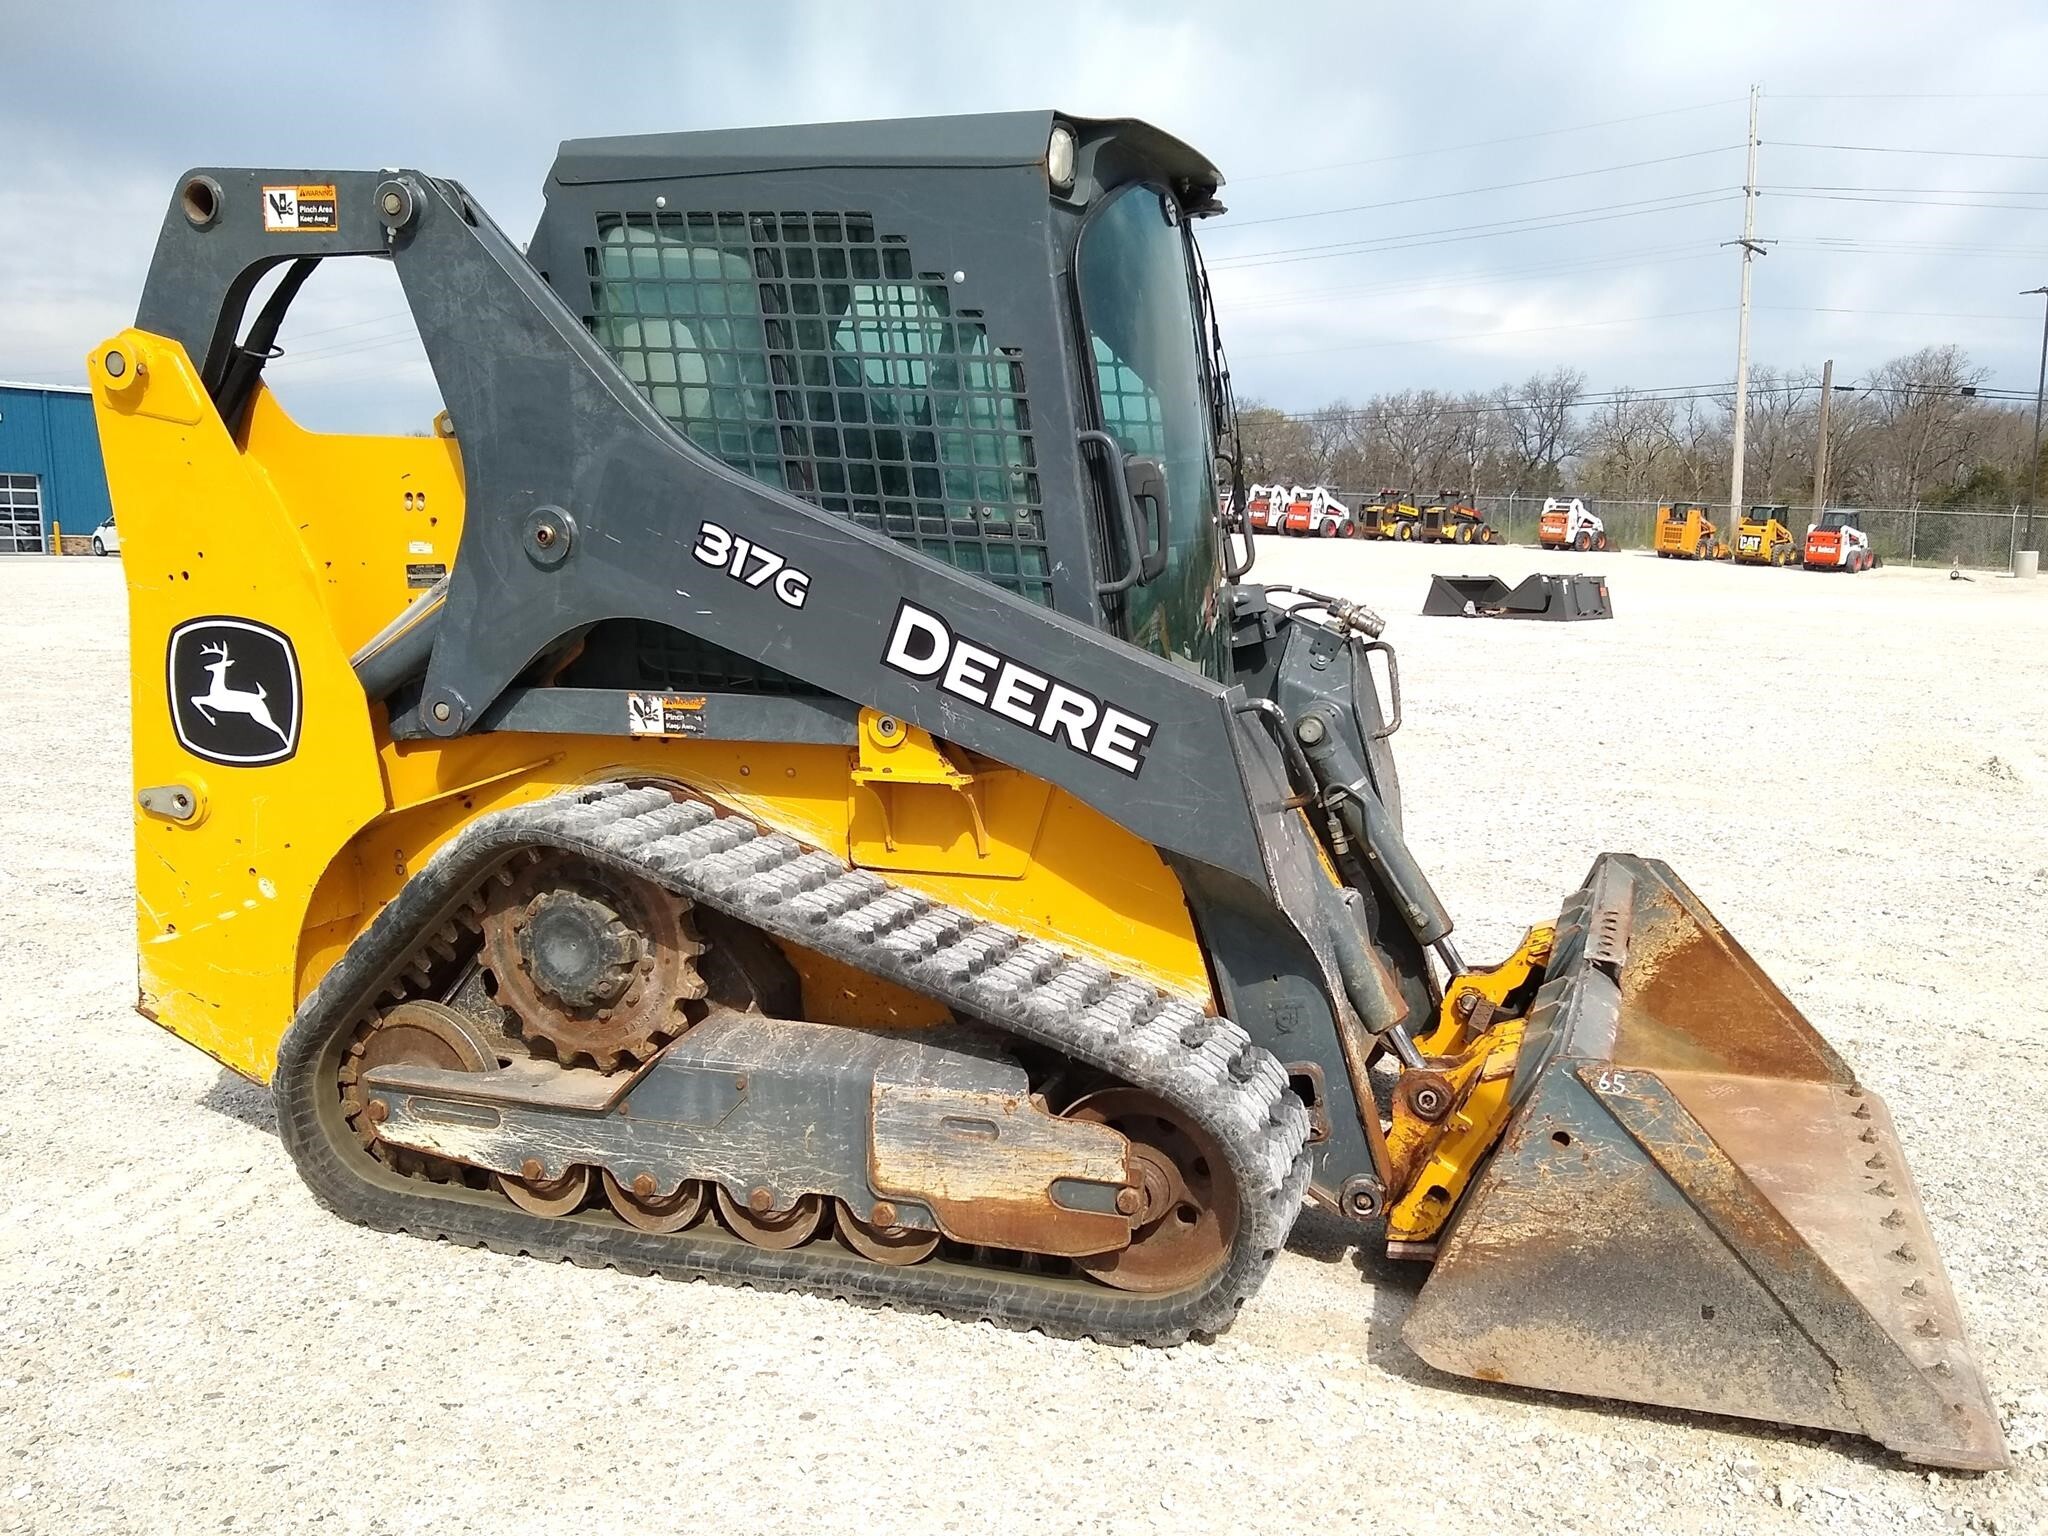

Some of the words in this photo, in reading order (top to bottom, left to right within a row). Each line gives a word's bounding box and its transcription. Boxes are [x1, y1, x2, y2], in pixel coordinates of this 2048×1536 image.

[304, 189, 333, 197] WARNING
[299, 205, 317, 213] Pinch
[318, 205, 333, 213] Area
[300, 215, 313, 224] Keep
[314, 215, 329, 224] Away
[1739, 535, 1761, 550] CAT
[694, 522, 810, 608] 317G
[886, 603, 1153, 773] DEERE
[1598, 1071, 1627, 1095] 65
